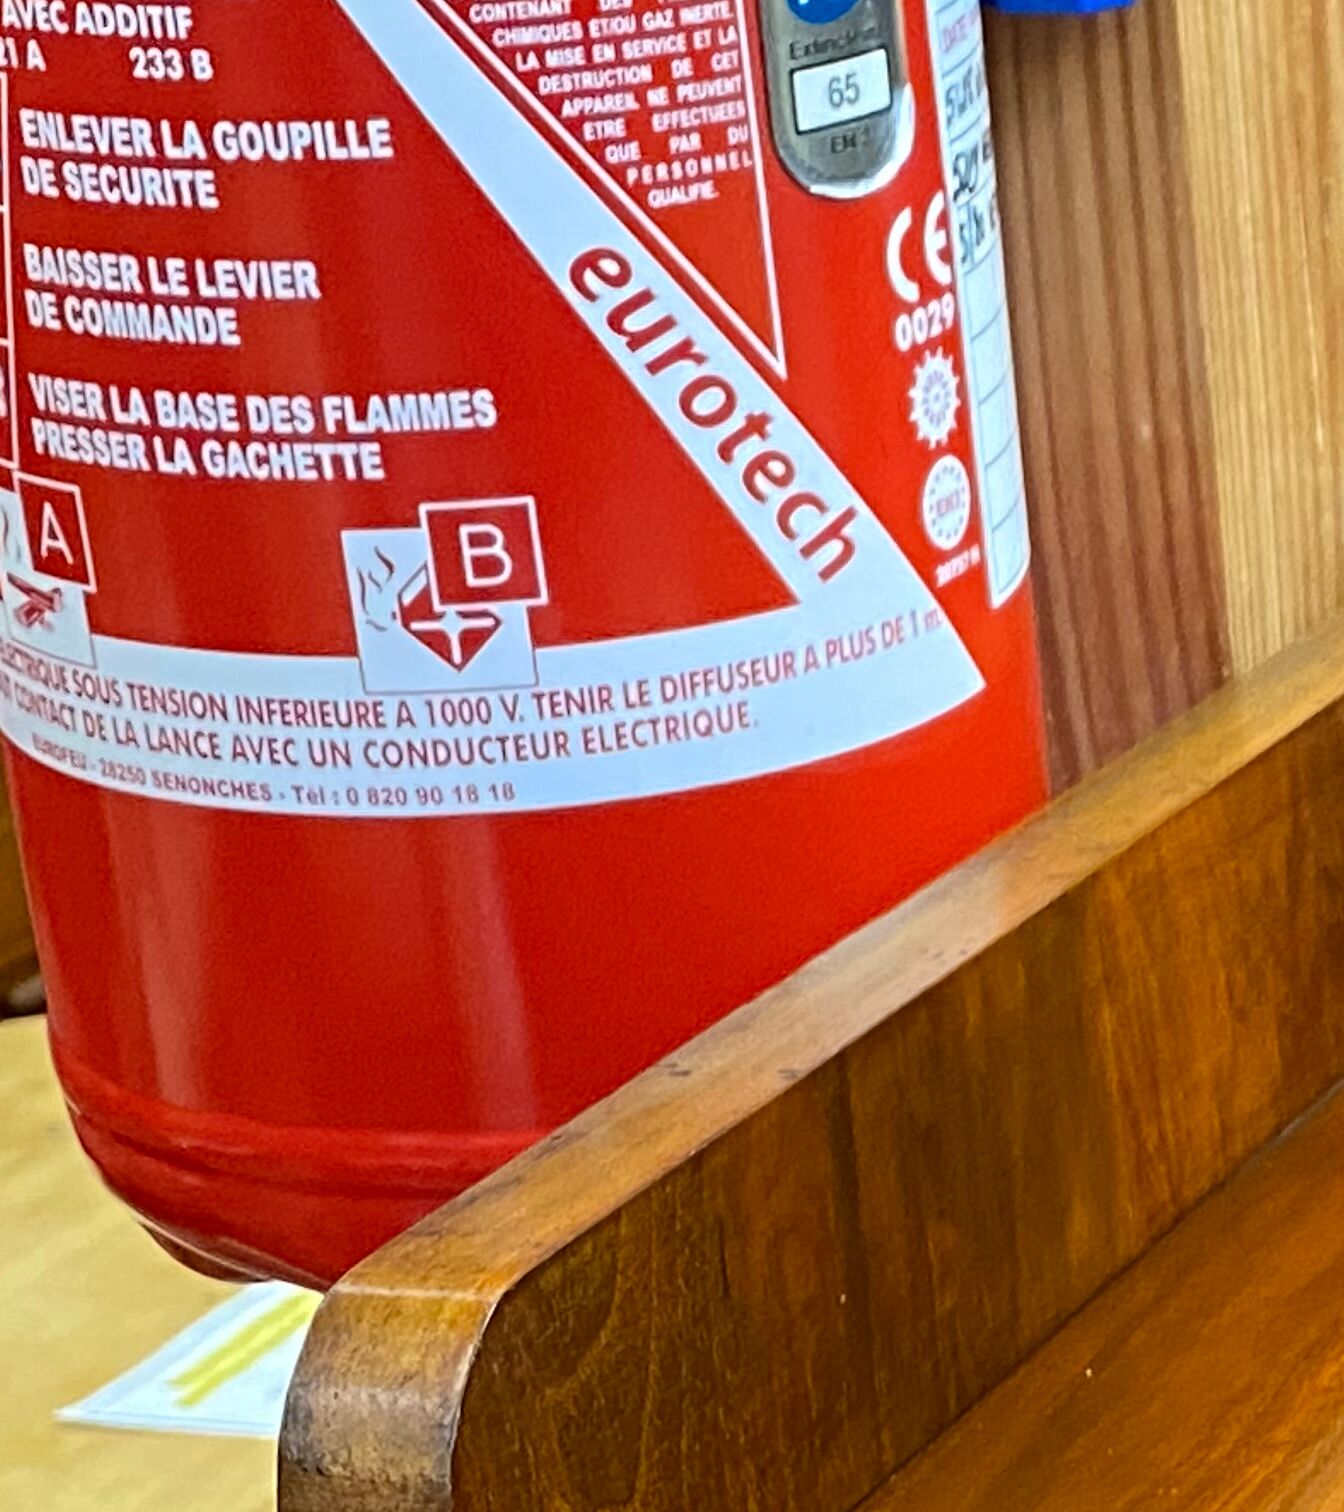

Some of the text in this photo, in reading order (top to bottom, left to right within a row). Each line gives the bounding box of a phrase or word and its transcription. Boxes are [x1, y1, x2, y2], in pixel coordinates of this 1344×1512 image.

[2, 0, 193, 40] AVEC ADDITIF
[469, 0, 571, 23] CONTENANT
[642, 8, 675, 31] GAZ
[27, 39, 46, 72] A
[129, 46, 213, 81] 233 B
[515, 24, 738, 72] LA MISE EN SERVICE ET LA
[538, 49, 739, 95] DESTRUCTION DE CET
[561, 75, 742, 118] APPAREIL NE PEUVENT
[828, 72, 861, 108] 65
[19, 107, 394, 161] ENLEVER LA GOUPILLE
[582, 100, 746, 142] ETRE EFFECTUEES
[605, 125, 749, 165] QUE PAR DU
[20, 157, 219, 210] DE SECURITE
[626, 151, 753, 187] PERSONNEL
[23, 243, 321, 301] BAISSER LE LEVIER
[24, 289, 240, 345] DE COMMANDE
[893, 292, 955, 352] 0029
[27, 372, 106, 416] VISER
[110, 384, 150, 426] LA
[154, 390, 240, 432] BASE
[247, 395, 315, 434] DES
[322, 389, 497, 434] FLAMMES
[568, 246, 859, 584] eurotech
[31, 416, 385, 481] PRESSER LA GACHETTE
[40, 502, 73, 565] A
[458, 523, 513, 588] B
[72, 668, 123, 708] SOUS
[125, 681, 229, 722] TENSION
[236, 695, 387, 730] INFERIEURE
[396, 700, 416, 729] A
[424, 696, 492, 728] 1000
[500, 693, 526, 723] V.
[531, 684, 614, 721] TENIR
[622, 677, 652, 708] LE
[659, 657, 797, 705] DIFFUSEUR
[803, 645, 821, 674] A
[825, 626, 877, 668] PLUS
[881, 616, 906, 647] DE
[14, 682, 77, 733] CONTACT
[82, 709, 107, 742] DE
[112, 716, 140, 749] LA
[143, 722, 223, 761] LANCE
[231, 733, 300, 768] AVEC
[307, 738, 351, 769] UN
[362, 728, 571, 769] CONDUCTEUR
[150, 769, 272, 802] SENONCHES
[367, 786, 407, 807] 820
[452, 784, 479, 805] 18
